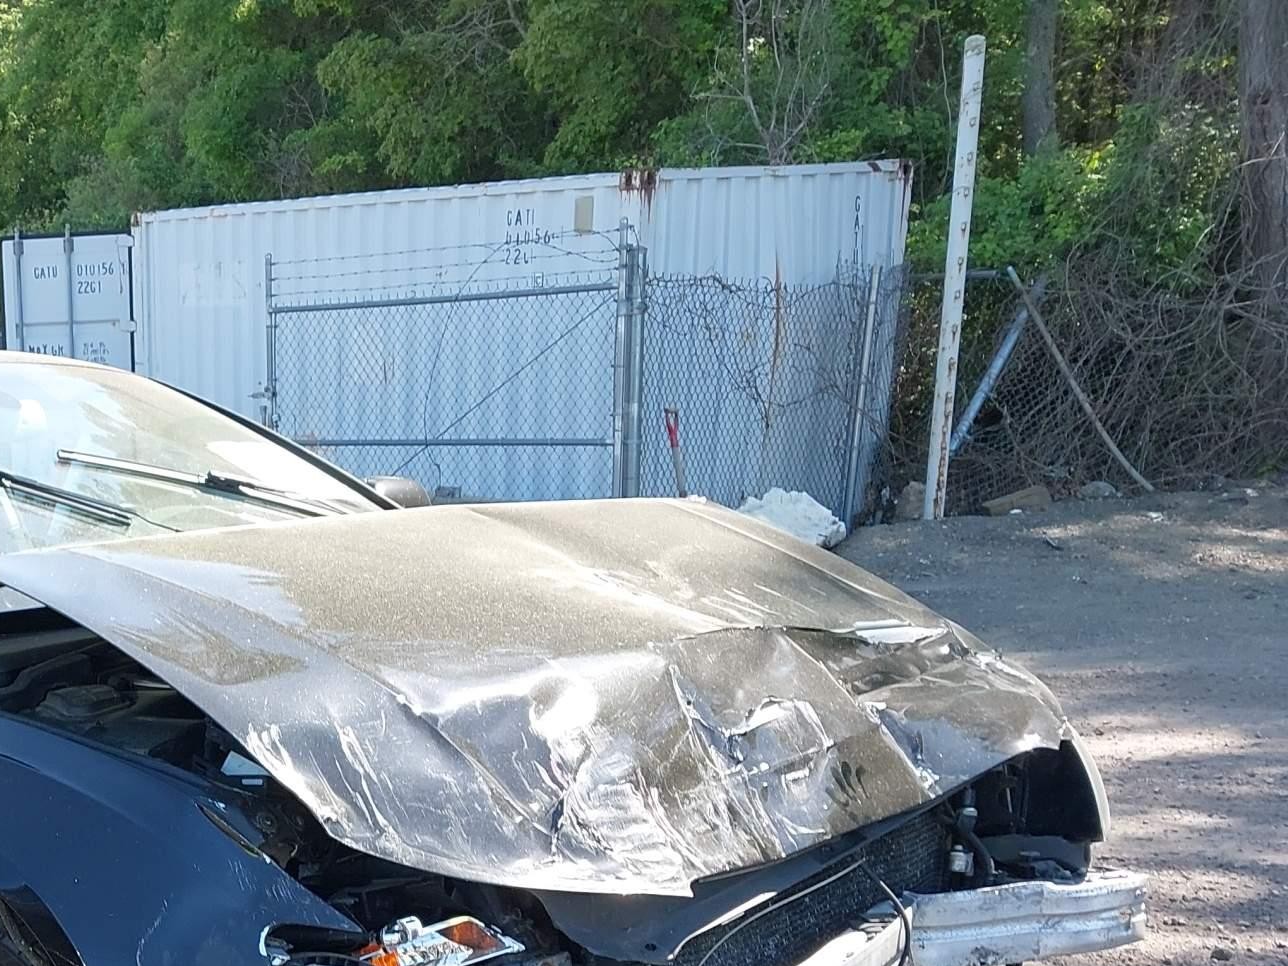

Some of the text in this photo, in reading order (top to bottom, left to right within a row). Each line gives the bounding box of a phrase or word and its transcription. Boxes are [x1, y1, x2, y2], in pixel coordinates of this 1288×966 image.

[33, 265, 58, 280] GATU
[76, 262, 114, 276] 010156
[77, 281, 101, 294] 22G1
